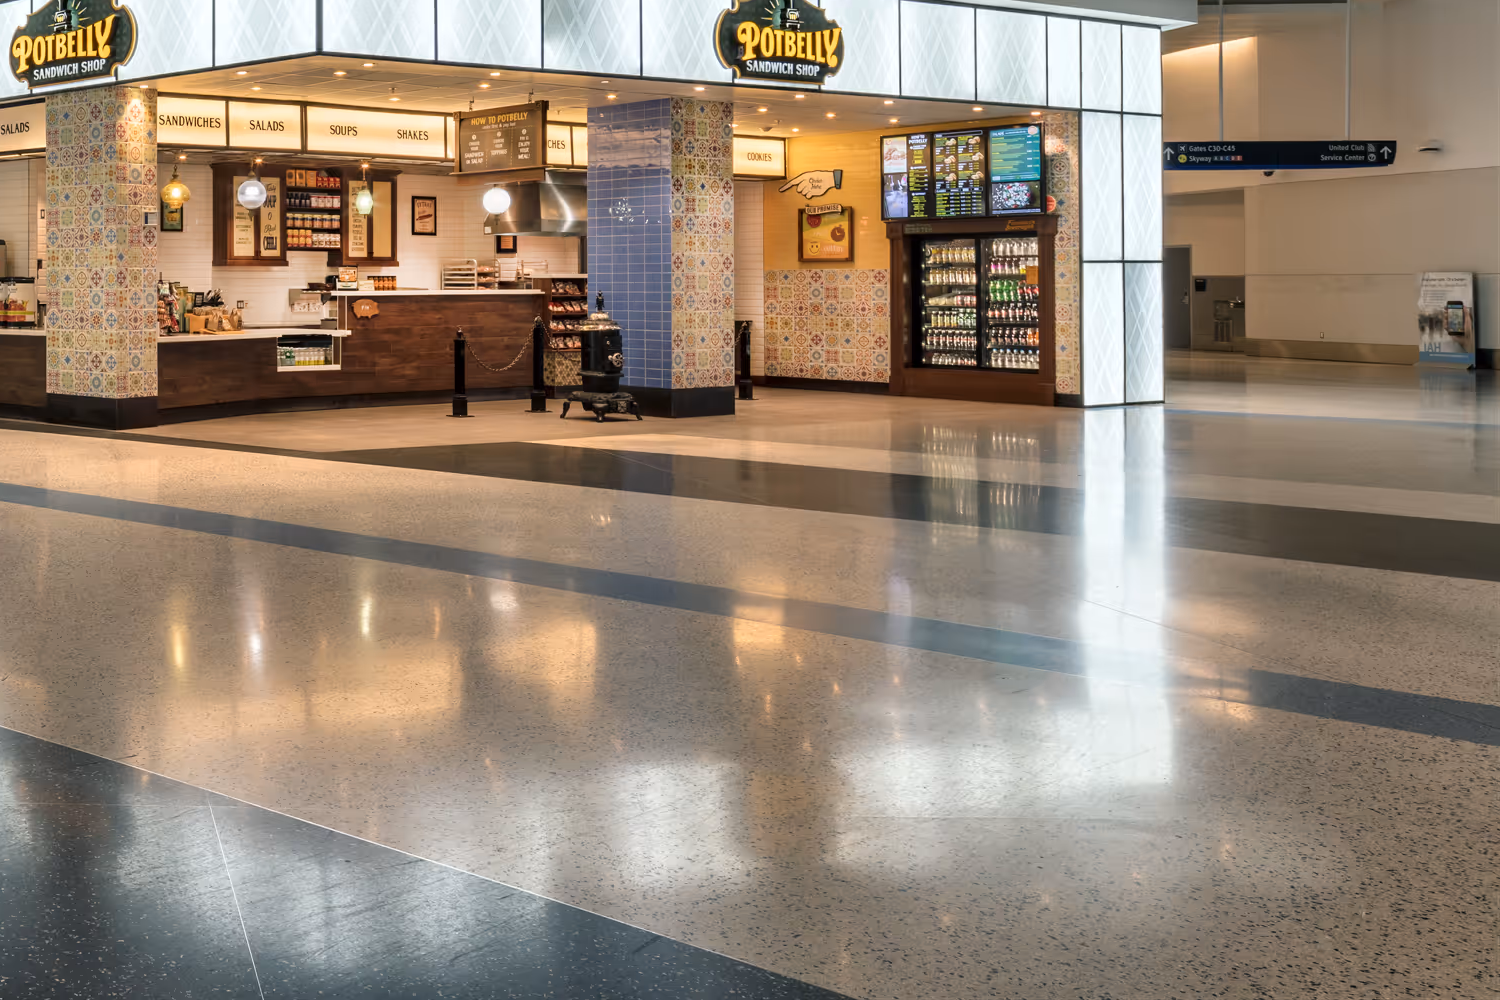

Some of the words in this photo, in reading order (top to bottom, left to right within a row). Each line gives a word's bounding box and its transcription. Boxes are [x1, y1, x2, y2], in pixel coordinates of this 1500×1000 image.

[12, 14, 116, 74] POTBELLY
[737, 21, 842, 68] POTBELLY
[33, 63, 79, 80] SANDWICH
[81, 59, 106, 73] SHOP
[746, 60, 794, 75] SANDWICH
[796, 64, 820, 77] SHOP
[159, 115, 221, 128] SANDWICHES
[249, 120, 284, 131] SALADS
[0, 122, 30, 135] SALADS
[329, 124, 358, 136] SOUPS
[397, 129, 429, 141] SHAKES
[747, 152, 772, 161] COOKIES
